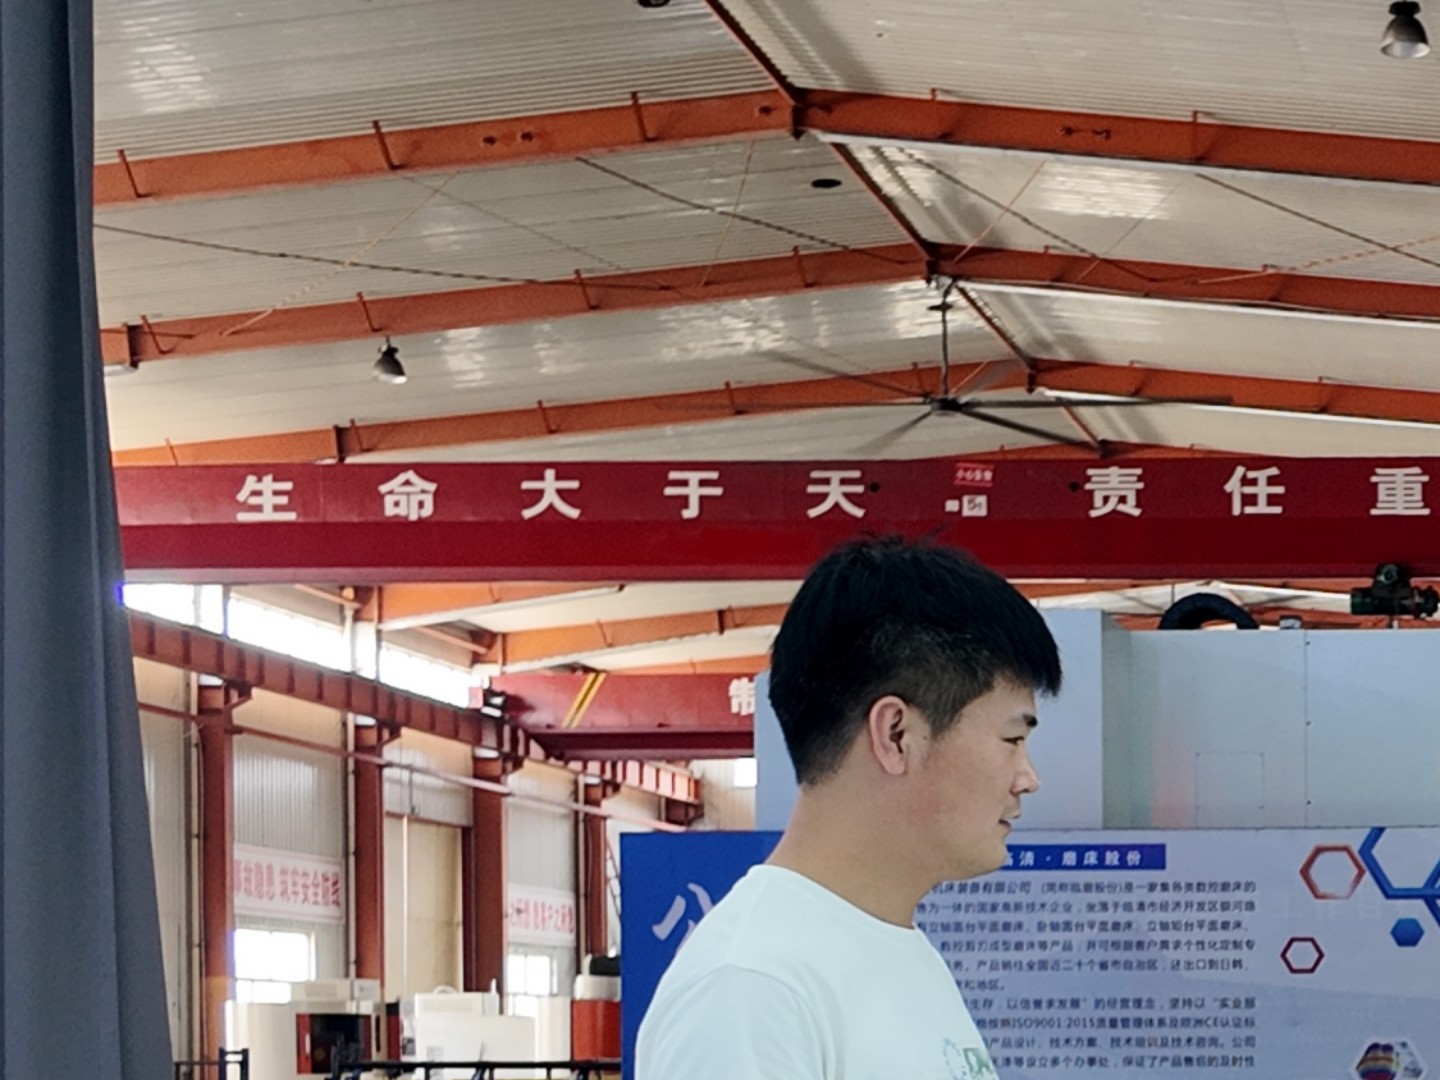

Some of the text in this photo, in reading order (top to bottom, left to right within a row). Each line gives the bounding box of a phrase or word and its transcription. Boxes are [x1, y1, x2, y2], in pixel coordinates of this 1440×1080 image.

[235, 469, 866, 522] 生命大于天
